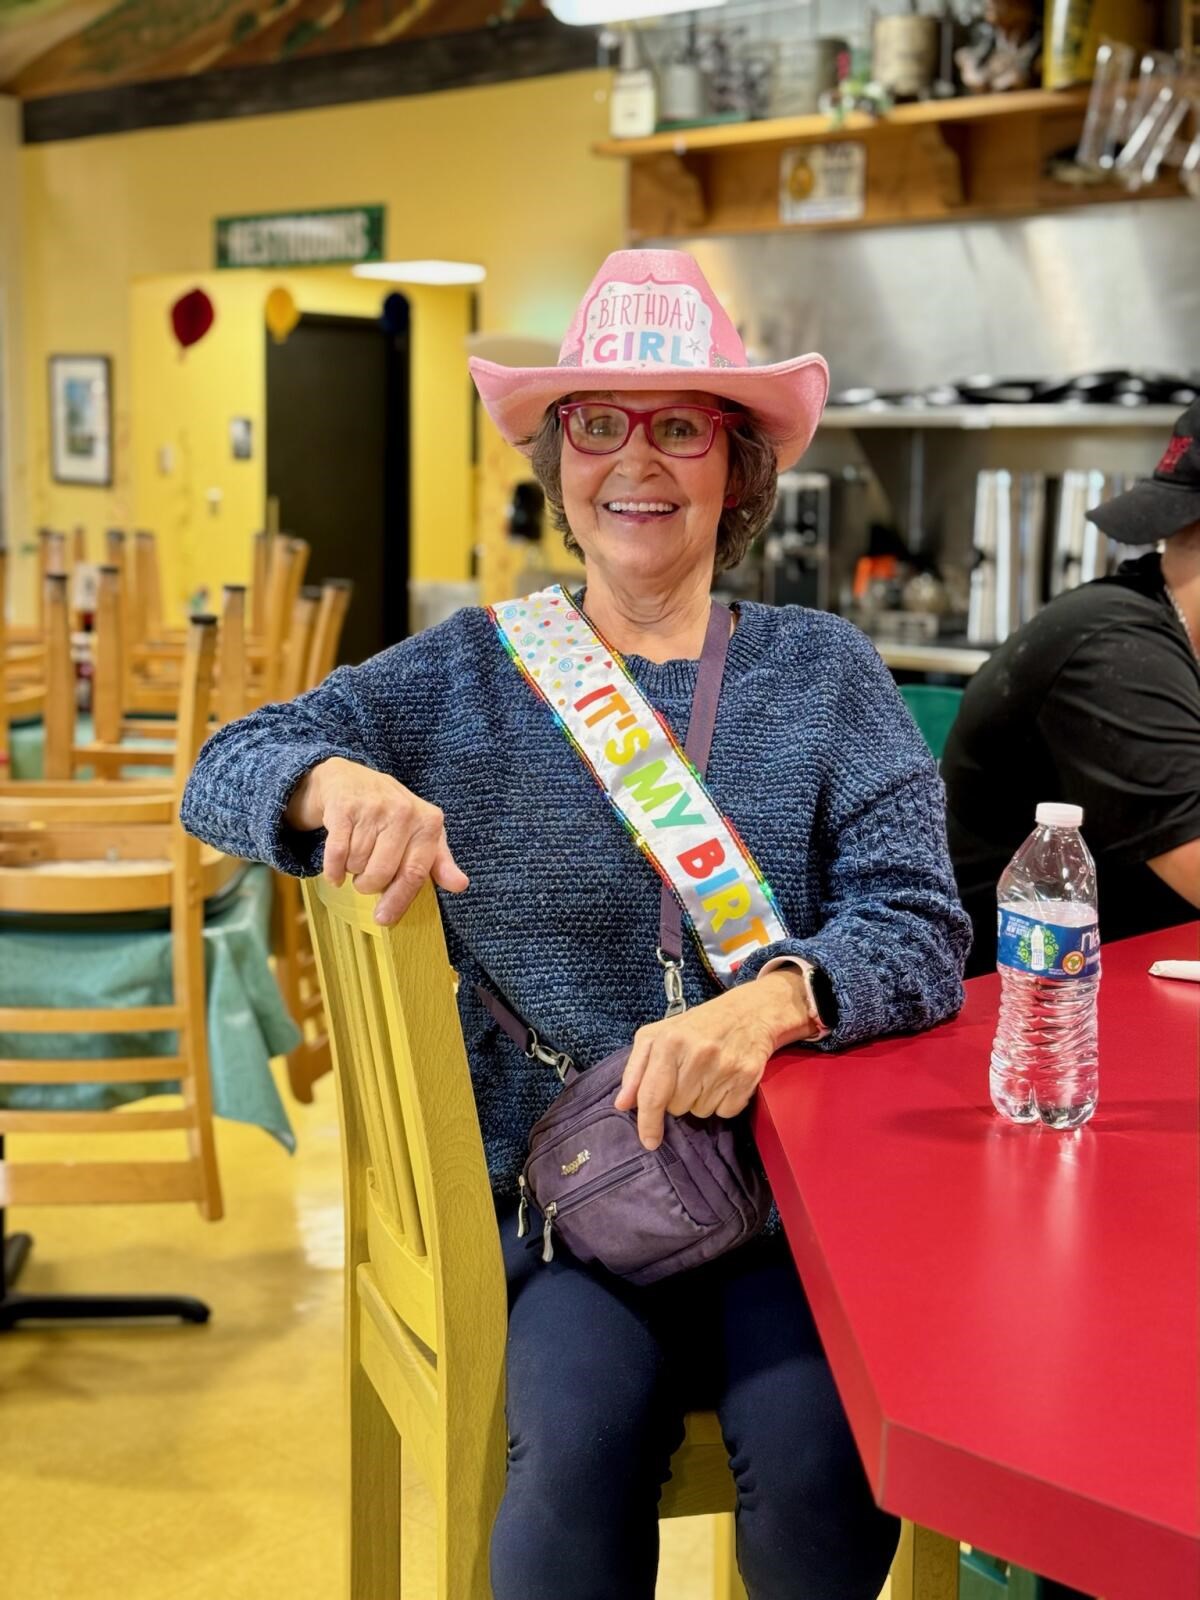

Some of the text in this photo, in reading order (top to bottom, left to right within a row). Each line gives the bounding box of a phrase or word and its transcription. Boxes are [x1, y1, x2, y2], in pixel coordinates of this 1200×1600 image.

[597, 293, 697, 332] BIRTHDAY
[593, 331, 694, 367] GIRL
[573, 683, 771, 972] IT'S MY BIRT
